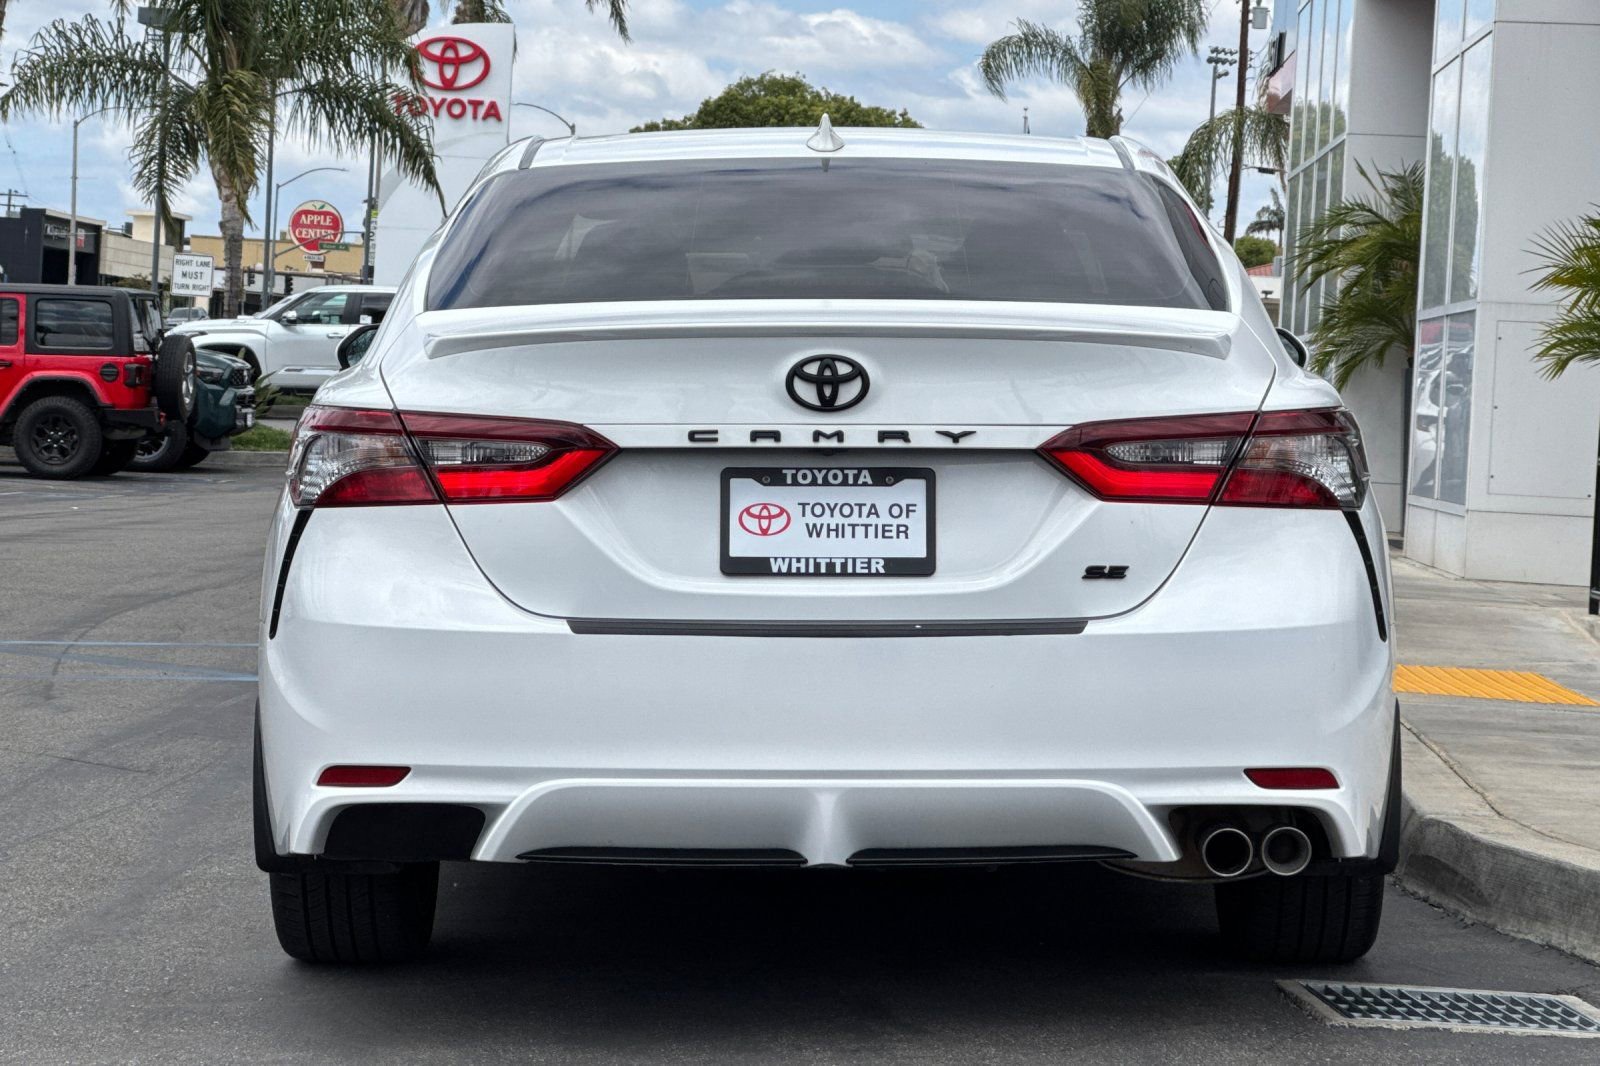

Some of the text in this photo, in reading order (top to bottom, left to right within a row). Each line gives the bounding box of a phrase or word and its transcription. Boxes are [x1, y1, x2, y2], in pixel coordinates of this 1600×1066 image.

[300, 214, 333, 226] APPLE
[295, 228, 336, 240] CENTER
[175, 258, 211, 268] RIGHT LANE
[181, 270, 204, 280] MUST
[174, 282, 210, 292] TURN RIGHT
[687, 429, 977, 444] CAMRY
[782, 469, 873, 485] TOYOTA
[798, 502, 917, 519] TOYOTA OF
[805, 522, 908, 540] WHITTIER
[770, 557, 886, 574] WHITTIER
[1081, 565, 1130, 580] SE
